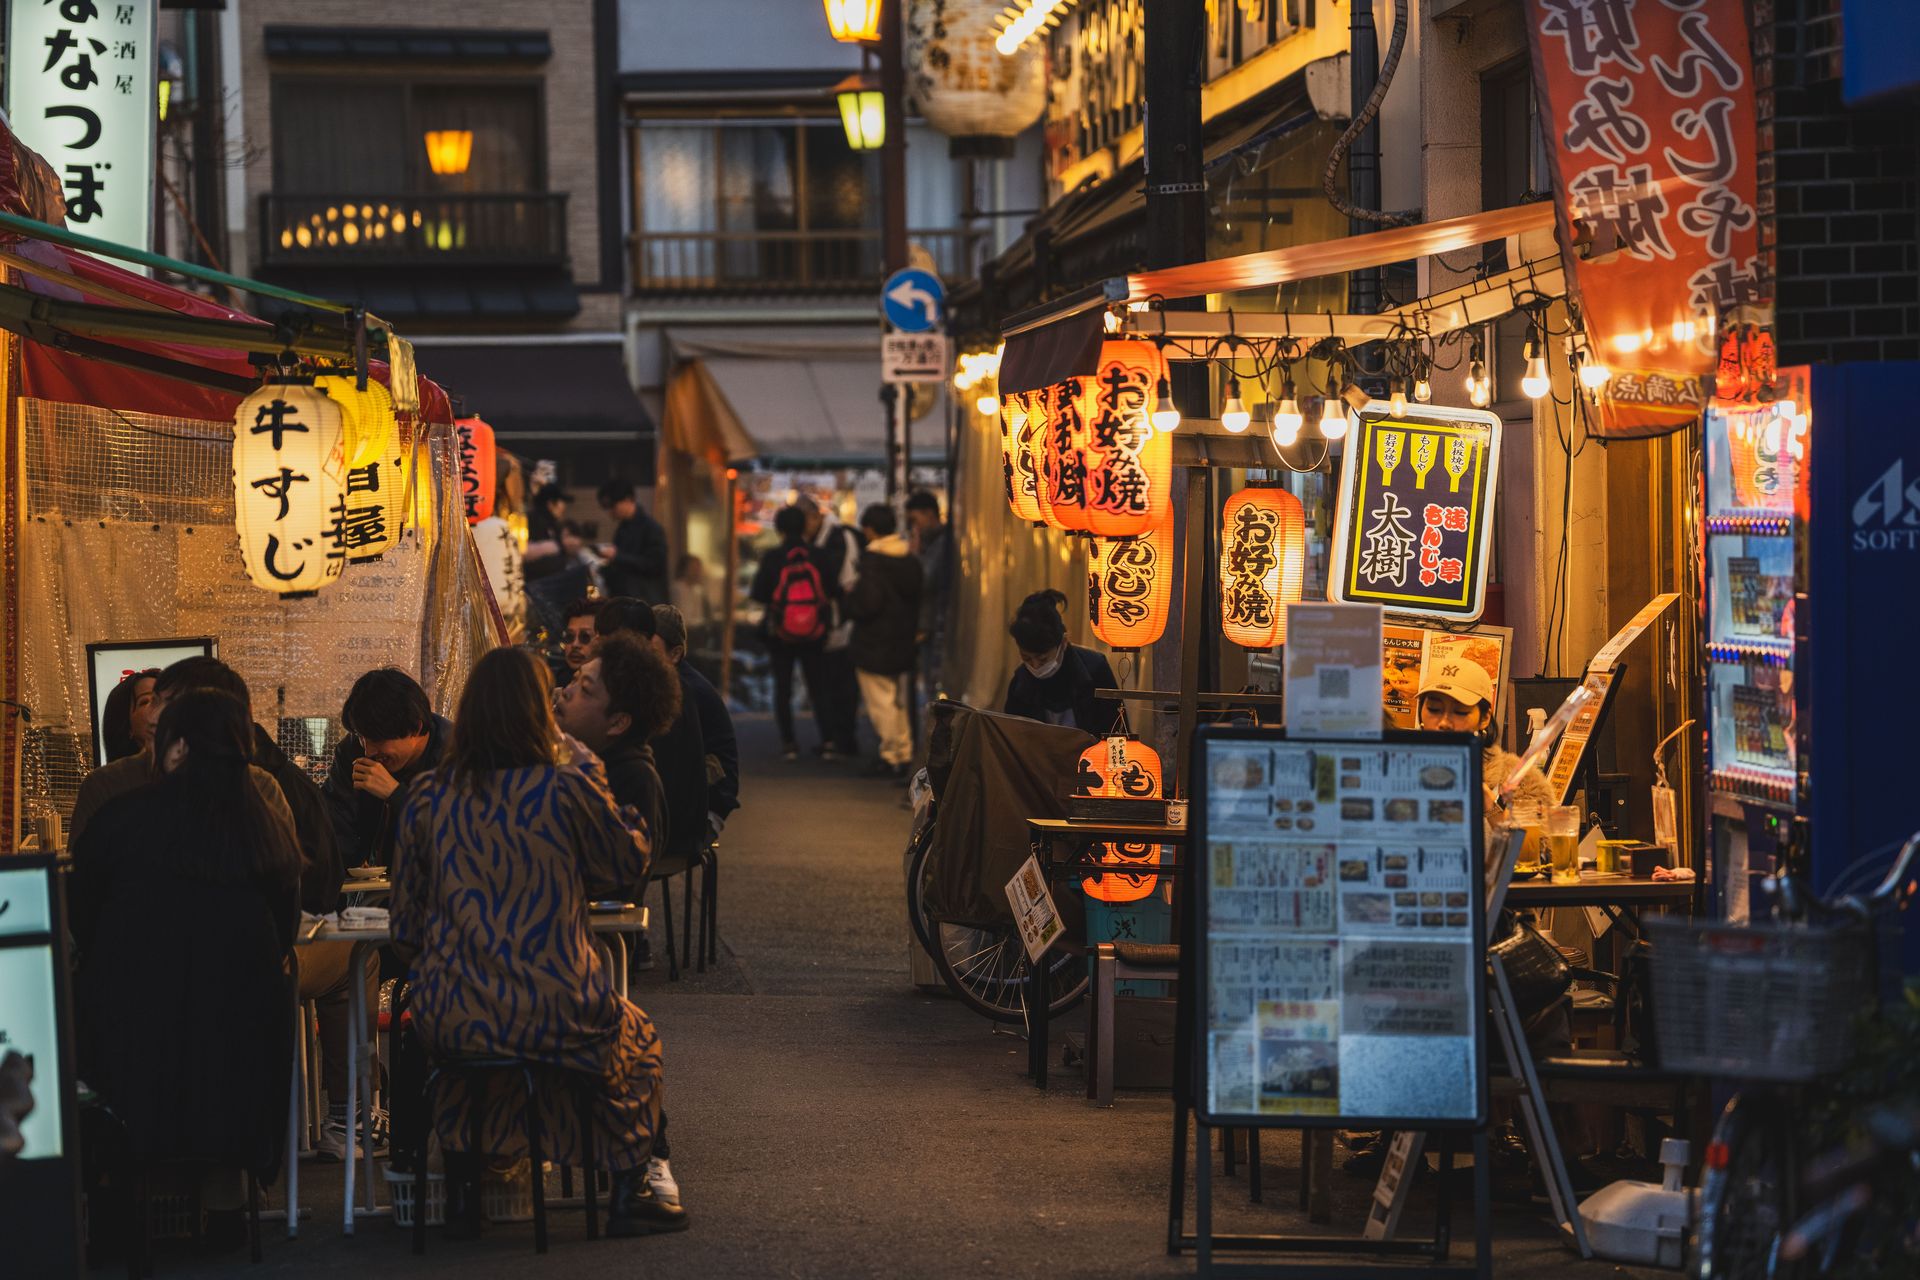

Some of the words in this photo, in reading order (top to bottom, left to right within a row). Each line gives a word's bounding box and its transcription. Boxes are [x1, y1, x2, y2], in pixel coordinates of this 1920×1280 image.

[114, 4, 136, 95] 居酒屋
[1092, 364, 1151, 514] お好み焼
[1383, 433, 1397, 469] お好み焼き
[1416, 435, 1431, 472] もんじゃ
[1451, 439, 1465, 473] 鉄板焼き
[250, 399, 313, 581] 牛すじ
[1228, 505, 1278, 627] お好み焼
[1360, 493, 1416, 586] 大樹
[1420, 504, 1445, 586] もんじゃ
[1853, 530, 1920, 551] SOFT
[1106, 539, 1156, 626] んじゃ
[1384, 638, 1420, 649] もんじゃ大樹
[1441, 665, 1459, 677] NY
